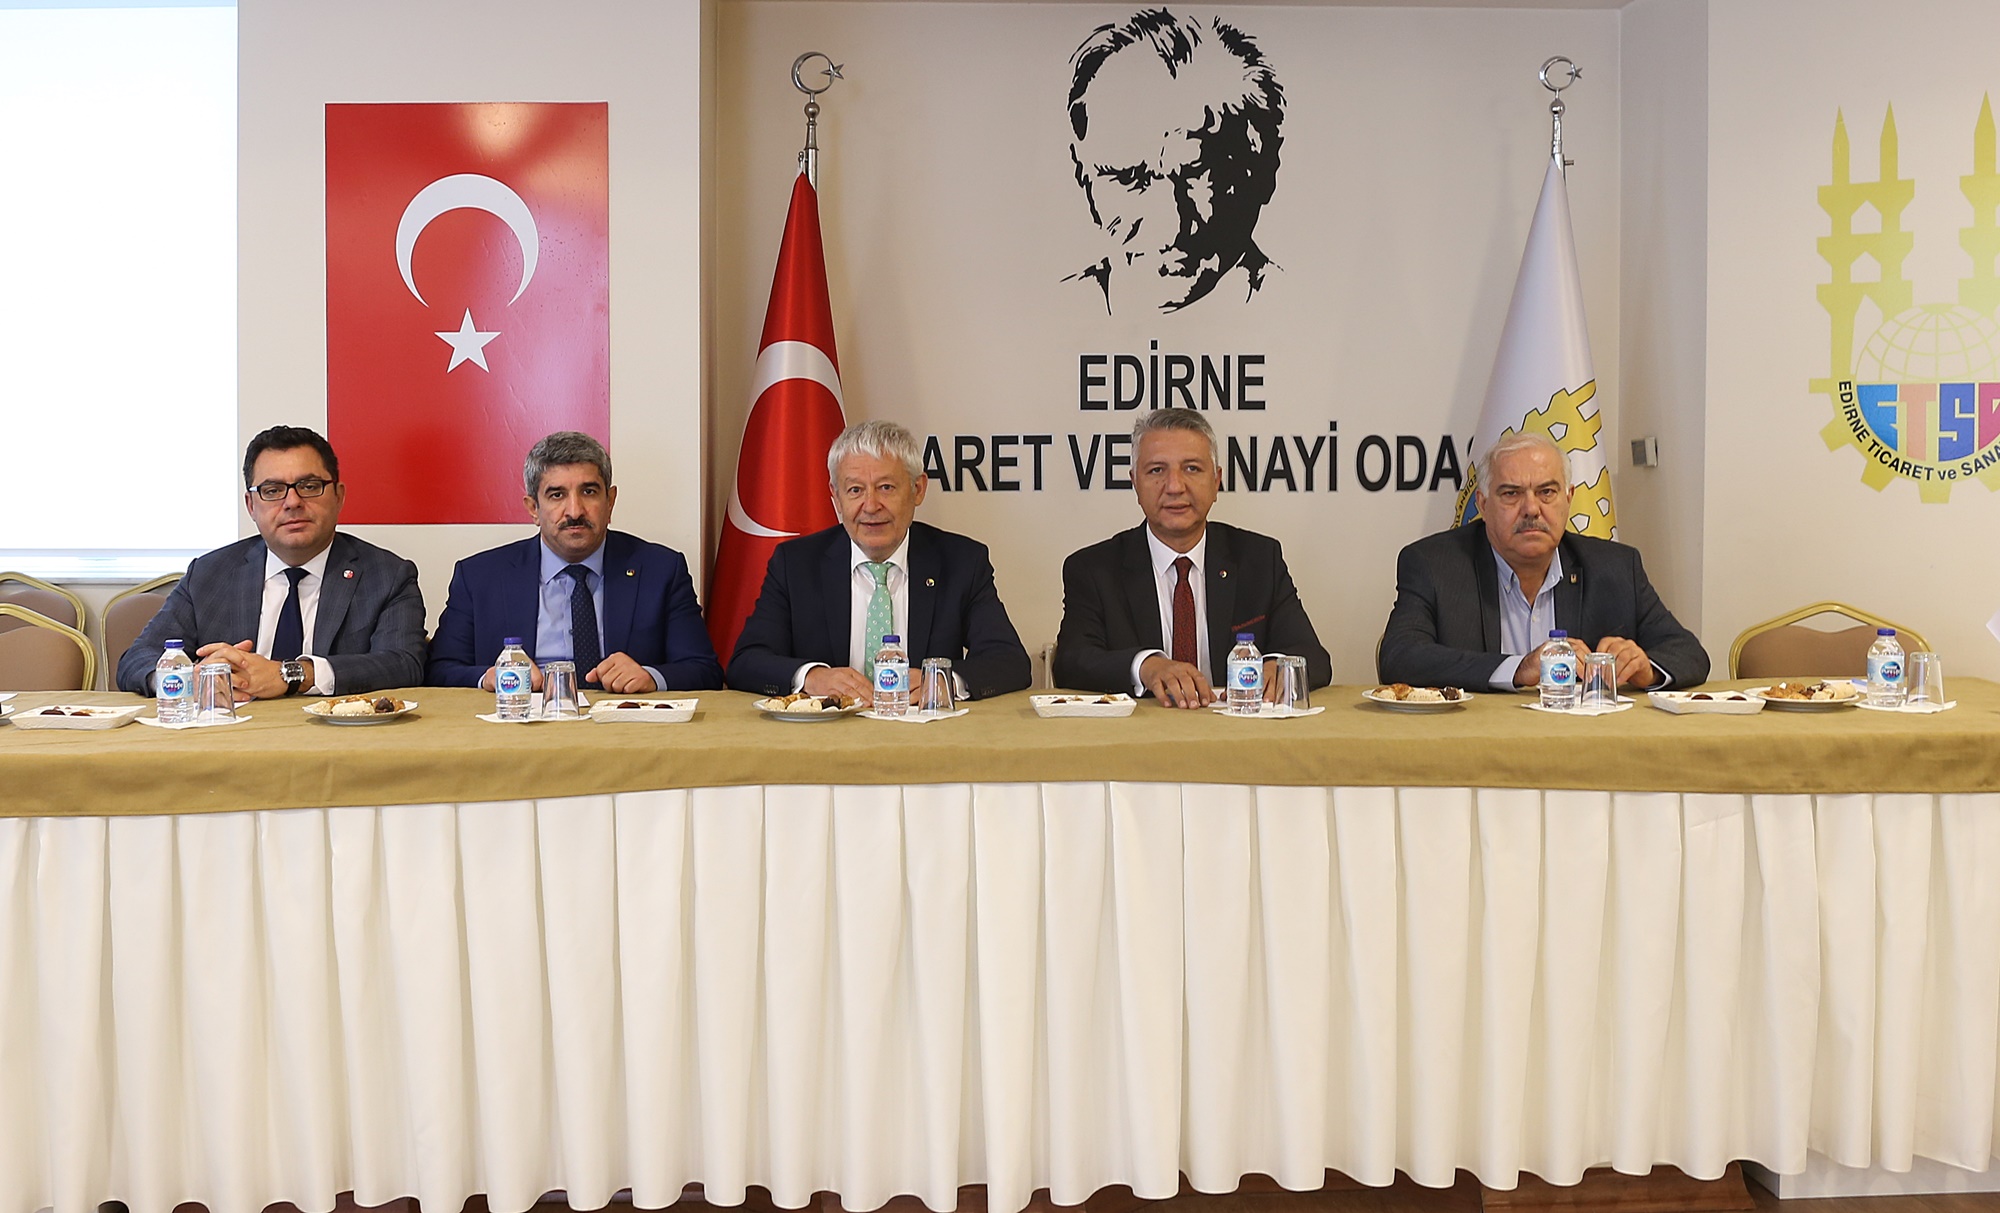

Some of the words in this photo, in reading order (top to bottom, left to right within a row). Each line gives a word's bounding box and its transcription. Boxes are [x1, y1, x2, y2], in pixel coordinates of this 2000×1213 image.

[1080, 340, 1266, 410] EDİRNE
[923, 435, 1052, 491] ARET
[1068, 434, 1133, 490] VE
[1218, 421, 1338, 491] NAYİ
[1356, 434, 1474, 492] ODA
[1938, 468, 1957, 480] ve
[1961, 441, 2000, 476] SANA
